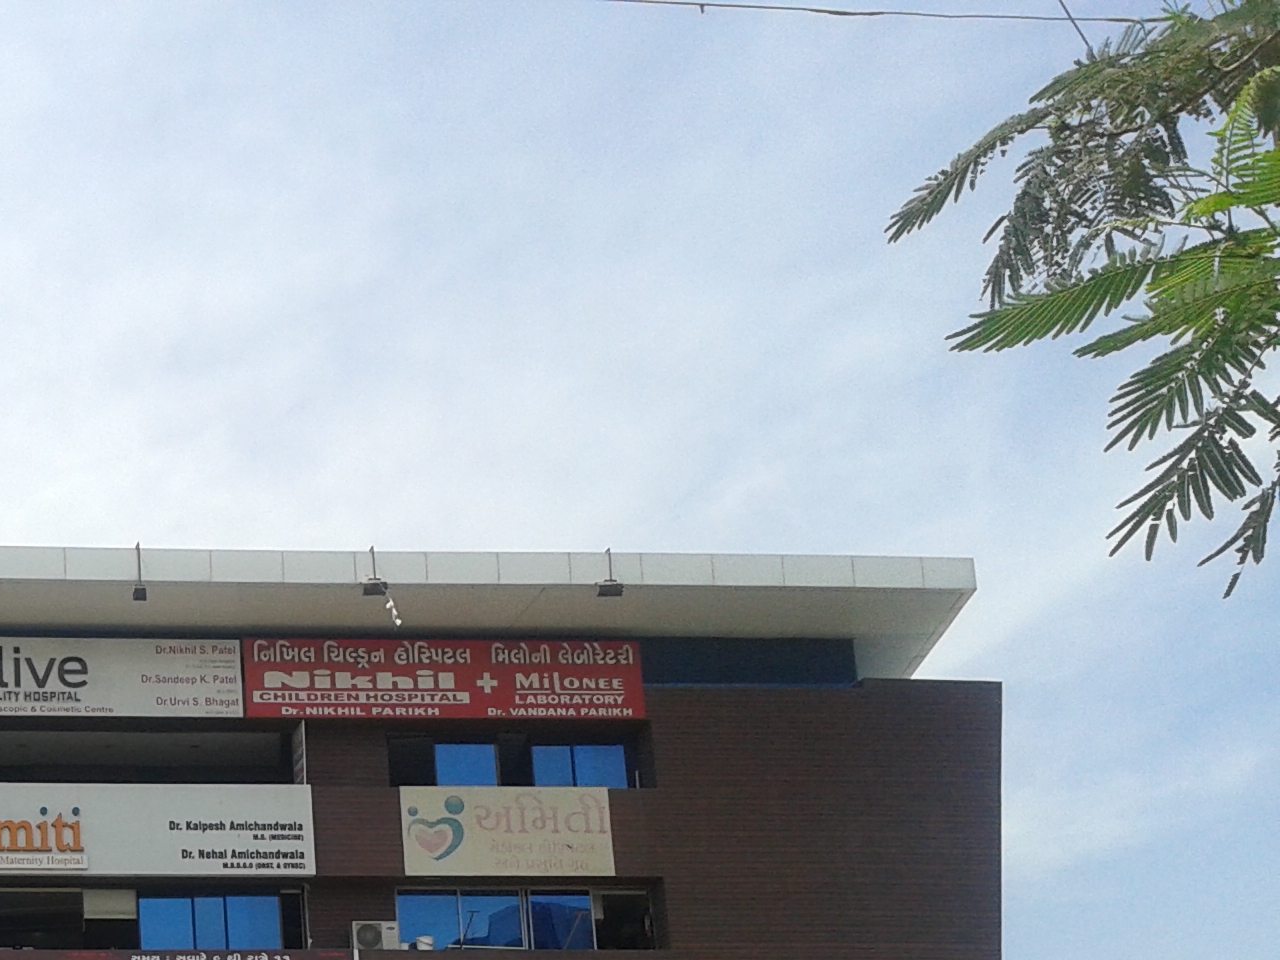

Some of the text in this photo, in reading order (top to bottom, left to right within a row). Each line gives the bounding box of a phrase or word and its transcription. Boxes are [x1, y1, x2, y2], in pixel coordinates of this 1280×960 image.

[199, 645, 208, 654] S.
[212, 645, 236, 654] Patel
[254, 640, 315, 663] નિખિલ
[393, 641, 470, 665] હોસ્પિટલ
[491, 643, 633, 665] મિલોની લેબોરેટરી
[200, 675, 210, 683] K.
[213, 675, 237, 683] Patel
[264, 669, 455, 689] Nikhil
[24, 691, 81, 703] HOSPITAL
[205, 697, 239, 708] Bhagat
[259, 692, 464, 703] CHILDREN HOSPITAL
[515, 695, 625, 705] LABORATORY
[39, 705, 81, 713] Cosmetic
[372, 707, 440, 716] PARIKH
[488, 708, 633, 716] Dr. VANDANA PARIKH
[169, 821, 303, 833] Dr. Kalpesh Amichandwala
[182, 849, 305, 859] Dr. Nehal Amichandwala
[0, 855, 44, 868] Maternity
[46, 856, 84, 868] Hospital
